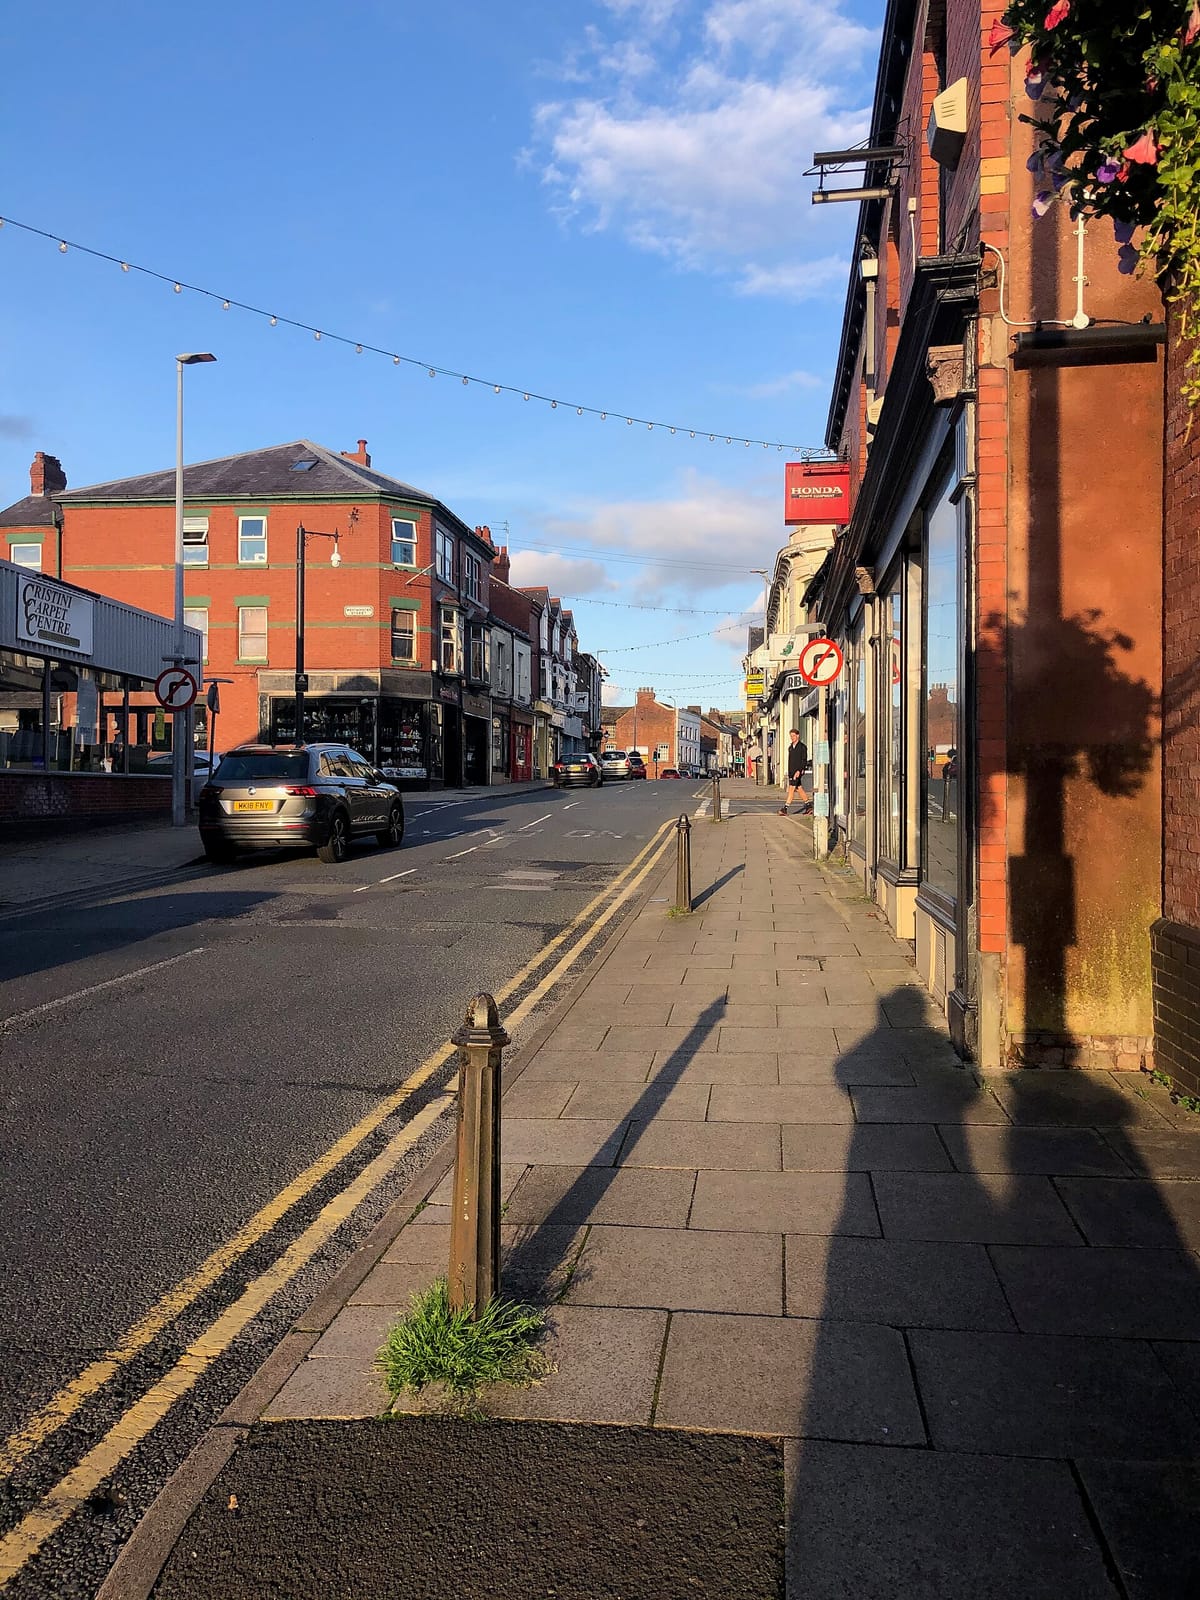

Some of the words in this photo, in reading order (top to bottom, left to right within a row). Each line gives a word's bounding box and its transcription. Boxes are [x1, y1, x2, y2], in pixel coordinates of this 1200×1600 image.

[23, 583, 73, 609] CRISTINI
[25, 598, 68, 621] CARPET
[26, 613, 71, 636] CENTRE
